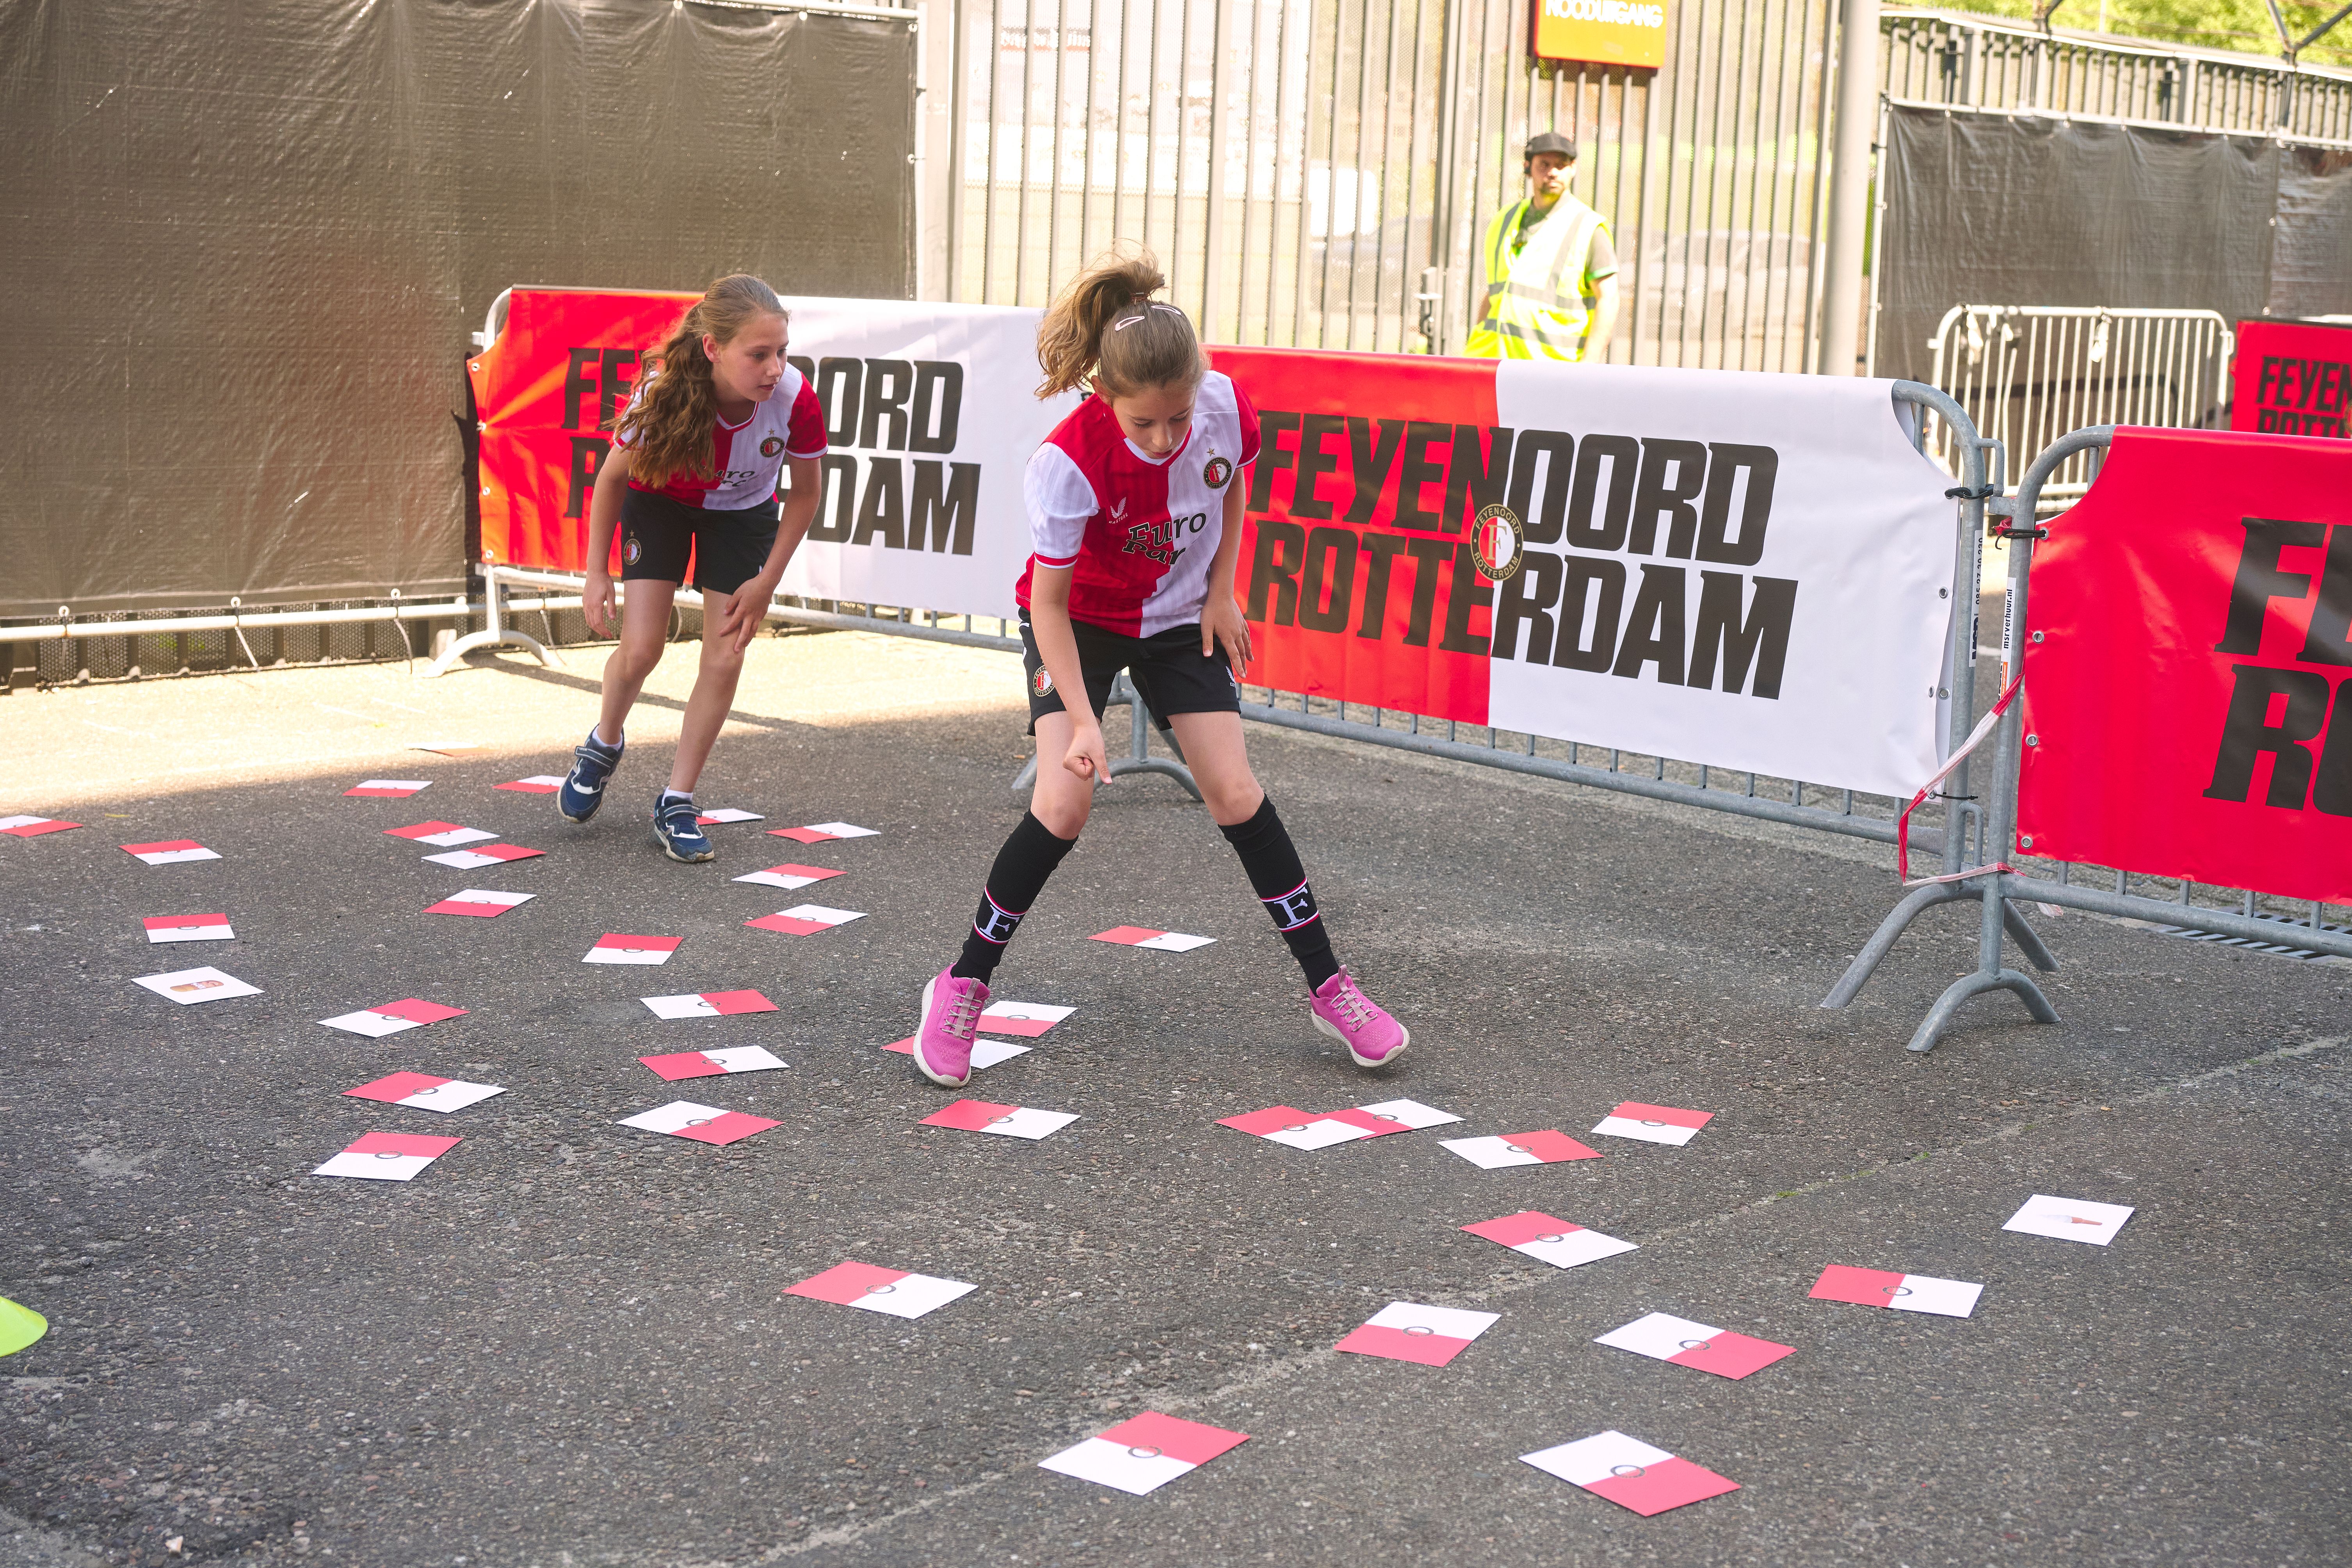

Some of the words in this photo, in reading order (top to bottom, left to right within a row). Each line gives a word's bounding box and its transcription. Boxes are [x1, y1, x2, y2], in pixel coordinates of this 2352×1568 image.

[1204, 459, 1229, 474] FEYENOORD
[1207, 471, 1231, 487] ROTTERDAM
[1246, 409, 1778, 566] FEYENOORD
[1128, 512, 1206, 547] Euro
[1475, 507, 1520, 534] FEYENOORD
[1474, 552, 1519, 578] ROTTERDAM
[1244, 519, 1798, 700] ROTTERDAM
[2003, 588, 2013, 649] msrverhuur.nl
[979, 904, 1020, 939] F
[1274, 886, 1308, 927] F
